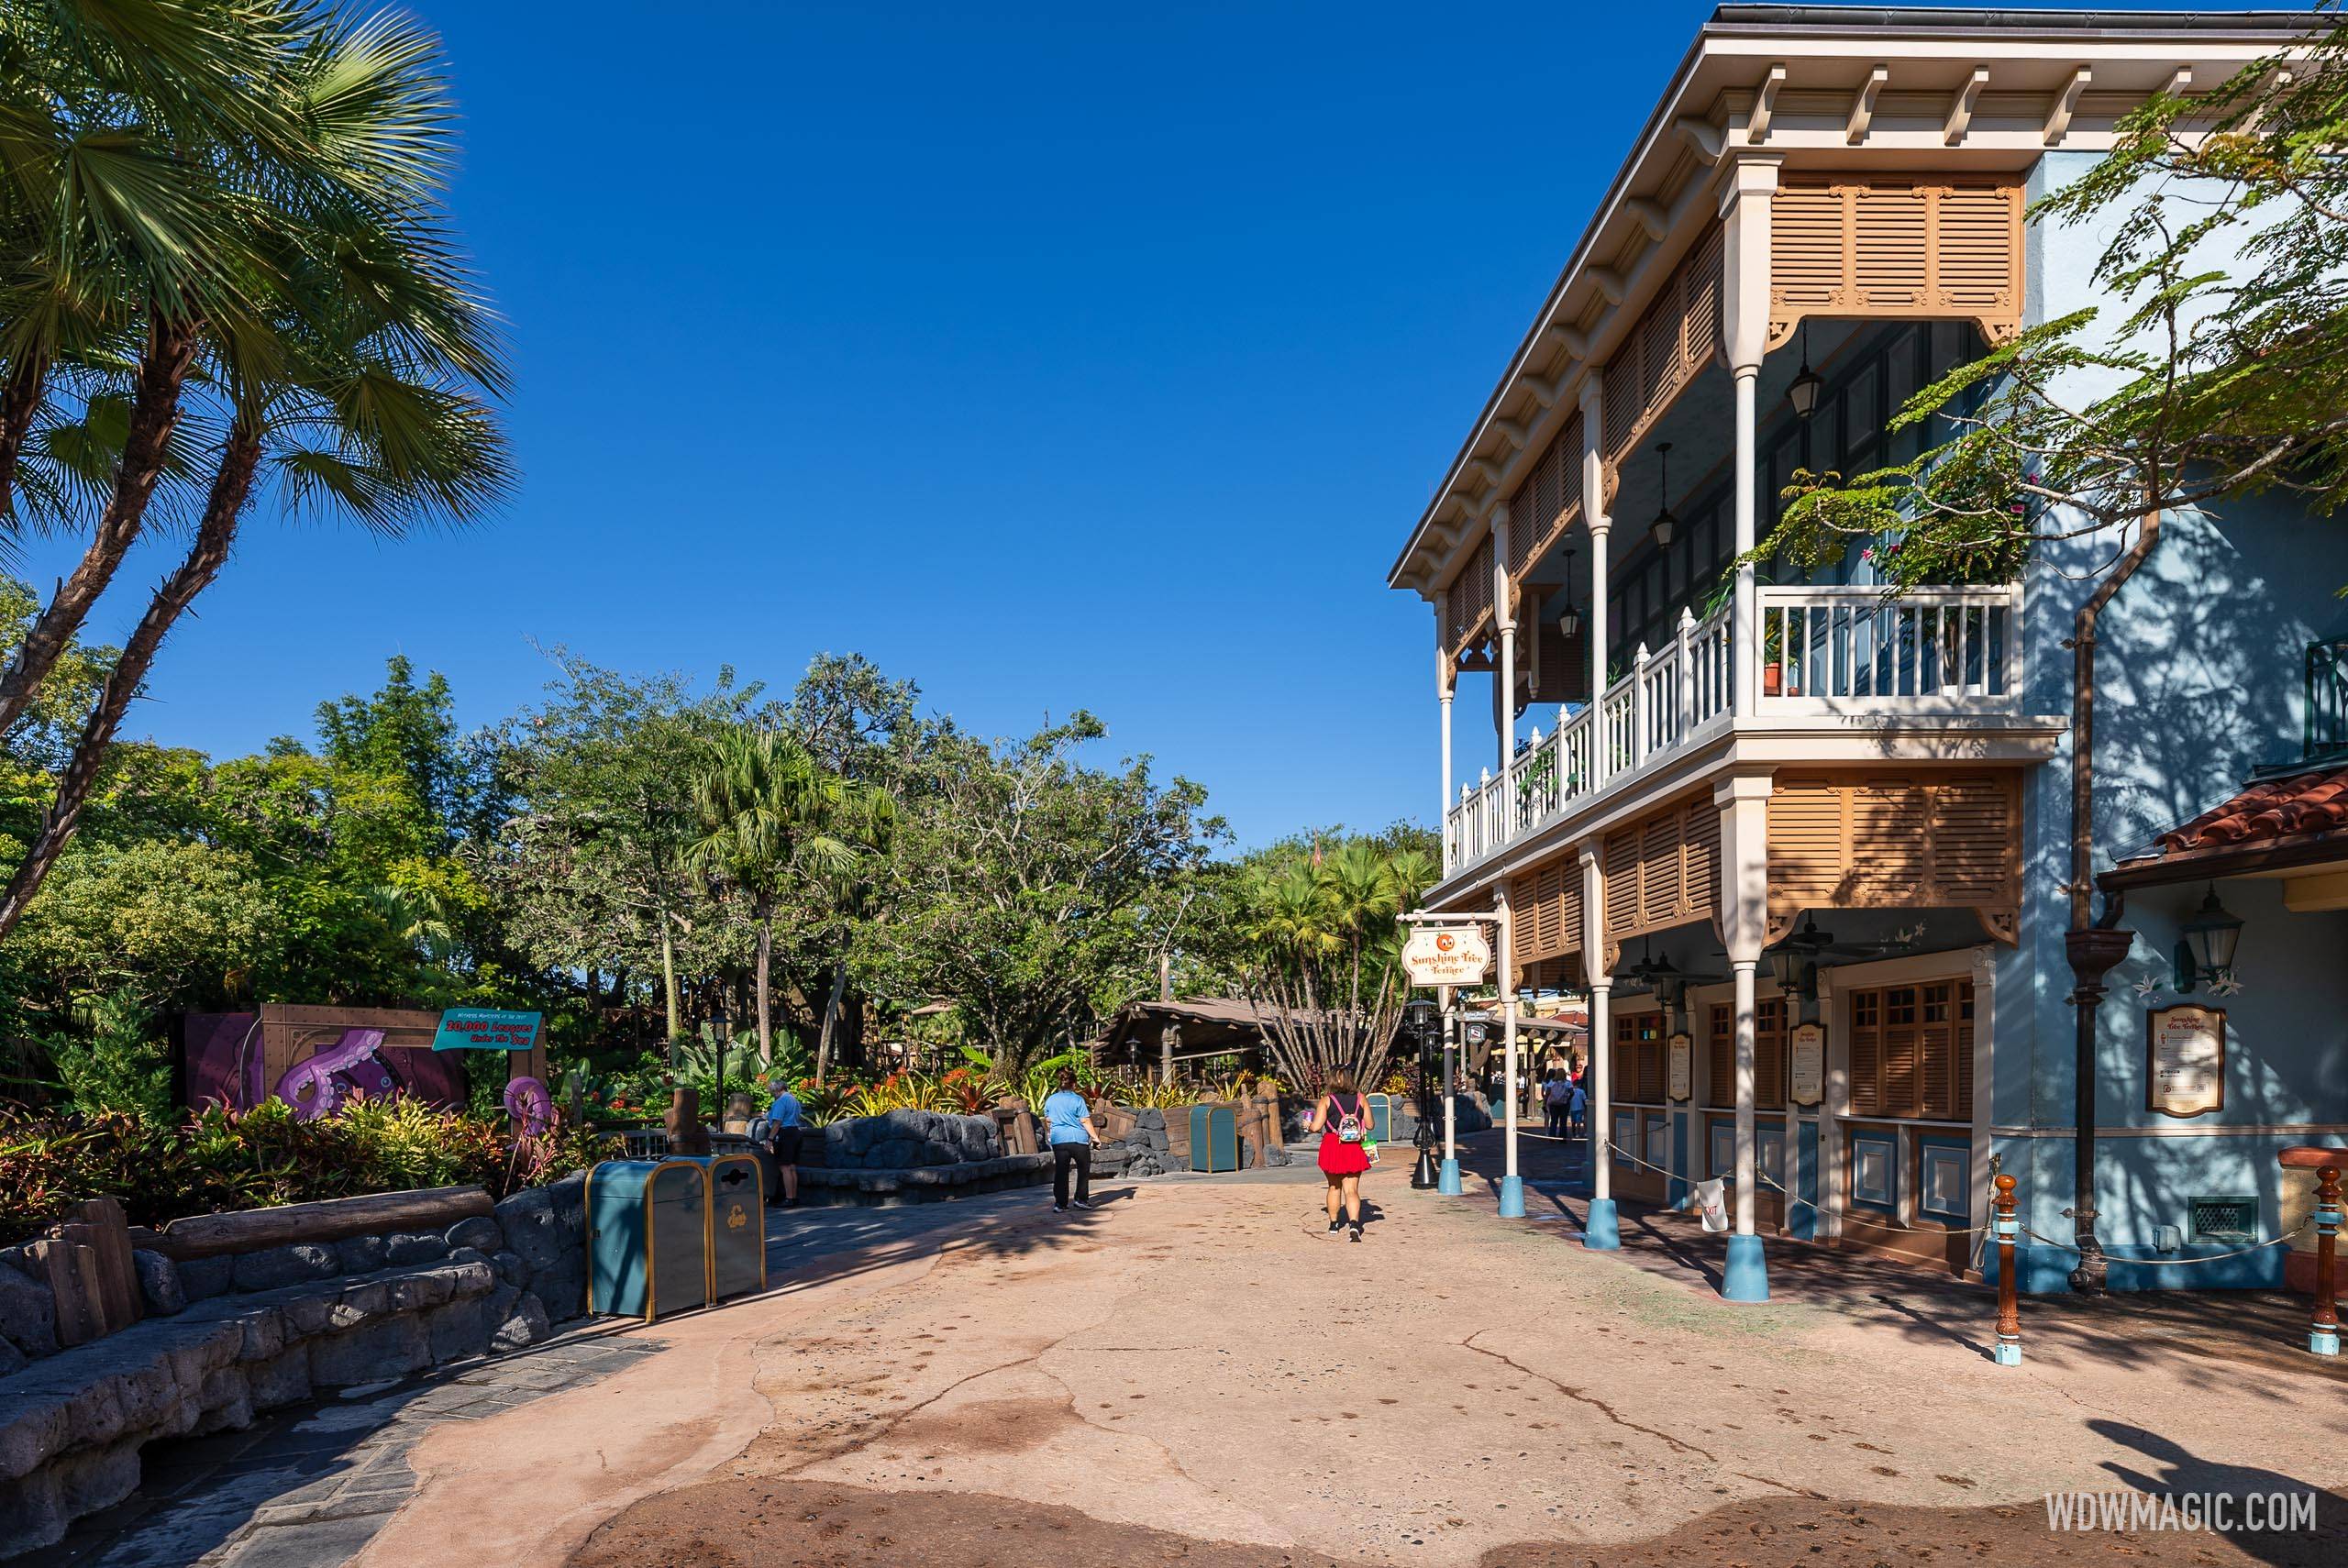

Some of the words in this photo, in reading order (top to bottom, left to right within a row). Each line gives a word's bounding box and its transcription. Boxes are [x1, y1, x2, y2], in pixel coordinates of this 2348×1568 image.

[1412, 954, 1459, 966] Sunshine
[1461, 952, 1483, 964] Tree
[1431, 966, 1464, 976] Terrace
[446, 1021, 488, 1032] 20,000
[491, 1022, 533, 1033] Leagues
[511, 1034, 529, 1044] Sea
